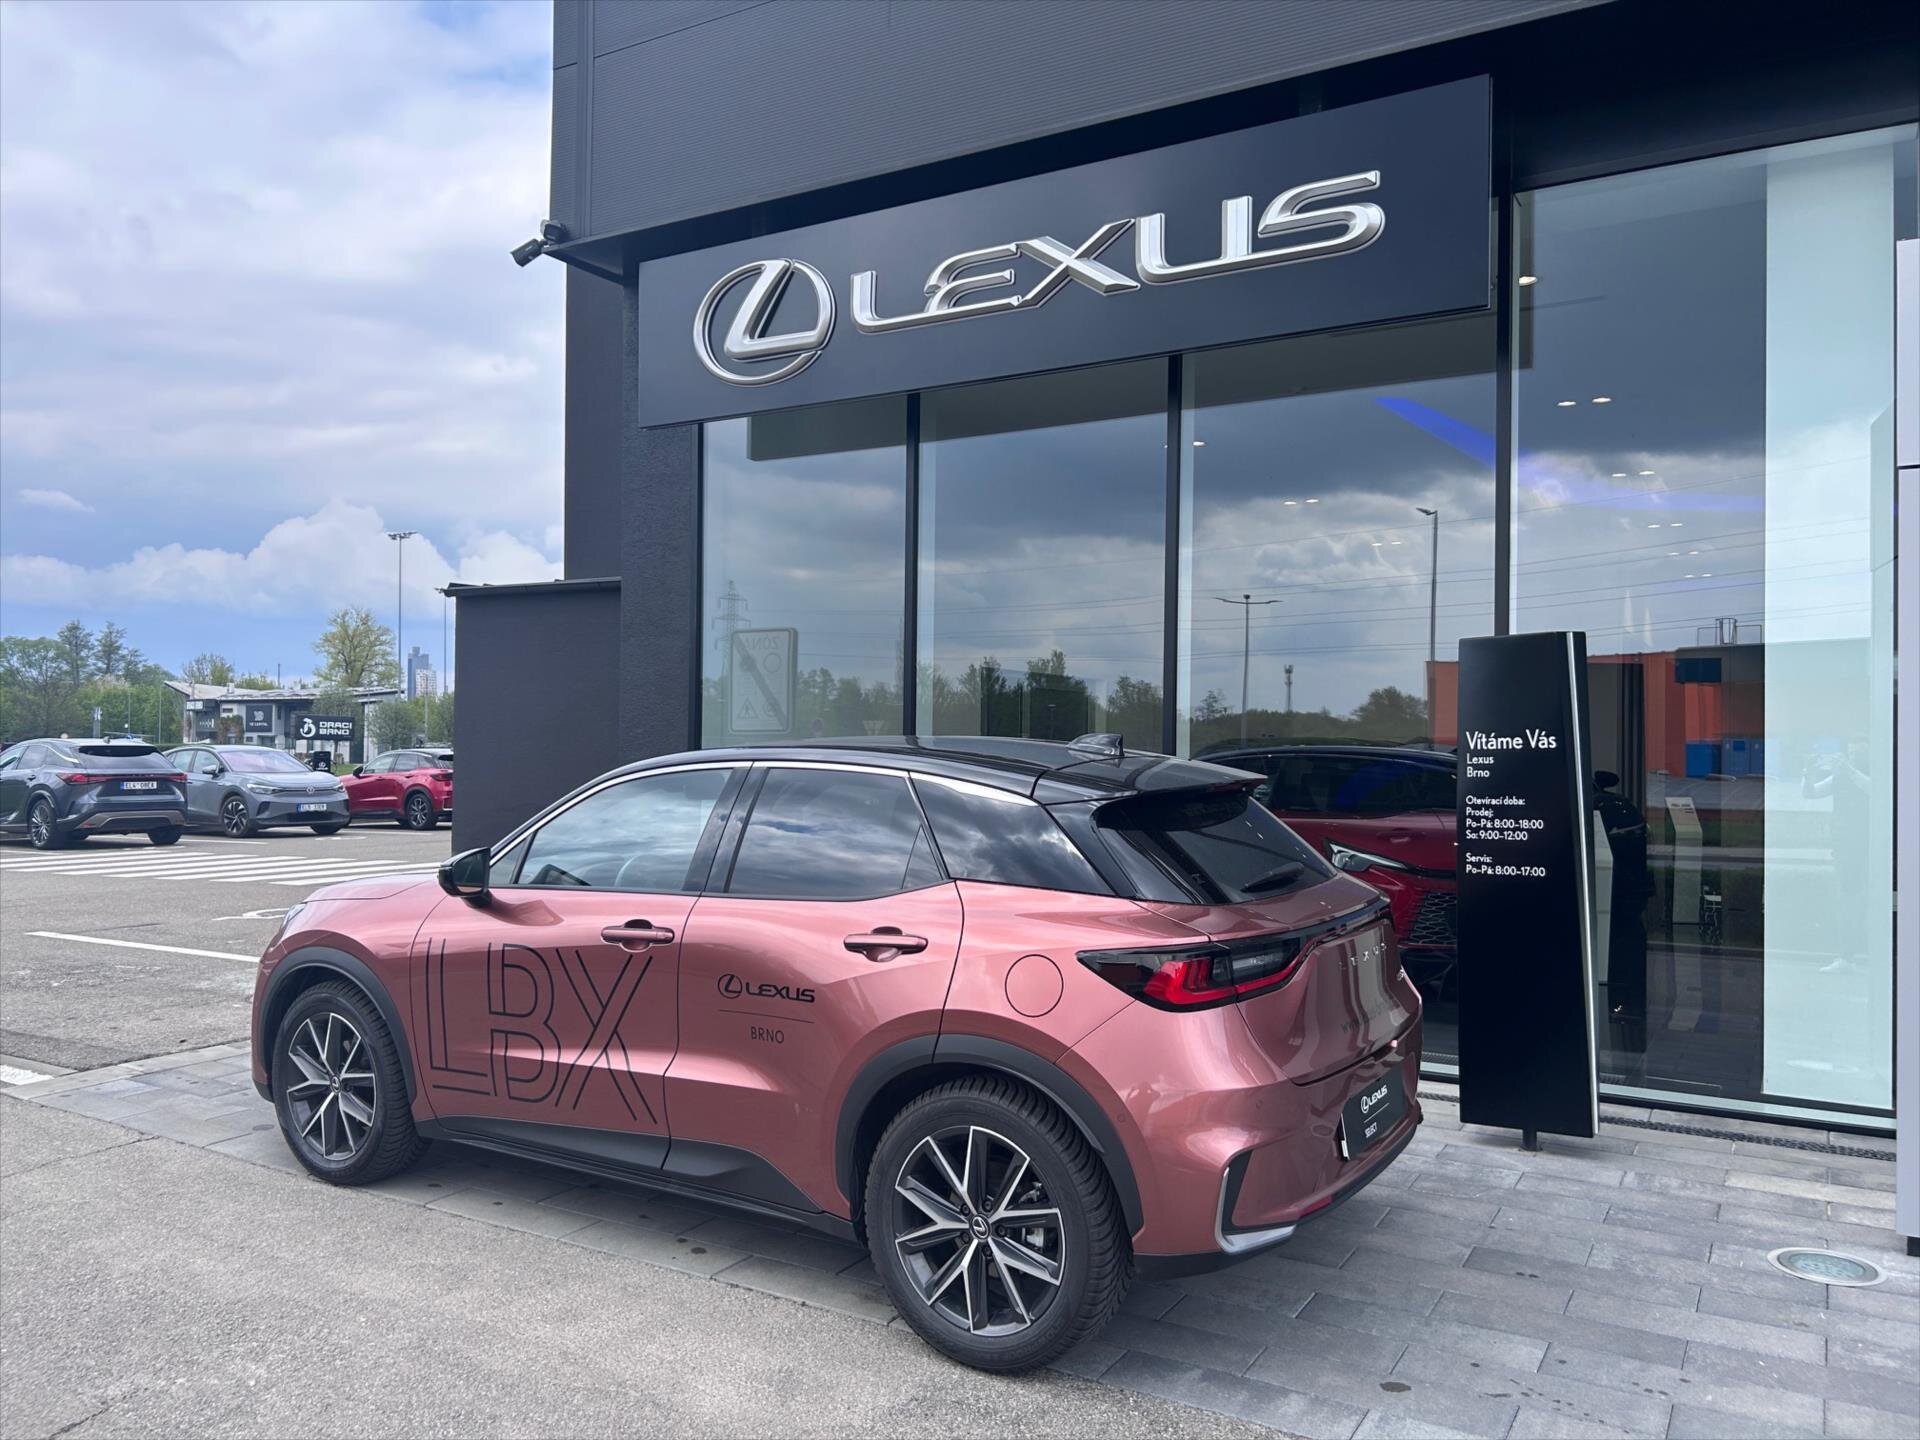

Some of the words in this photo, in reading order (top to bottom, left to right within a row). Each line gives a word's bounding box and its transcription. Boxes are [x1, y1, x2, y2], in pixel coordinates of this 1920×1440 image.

[850, 169, 1387, 335] LEXUS
[1465, 731, 1523, 750] Vítáme
[1525, 728, 1557, 749] Vás
[1466, 753, 1494, 764] Lexus
[1466, 766, 1490, 778] Brno
[1465, 795, 1502, 805] Otevírací
[1503, 795, 1526, 806] doba:
[1466, 806, 1494, 818] Prodej:
[1466, 829, 1479, 840] So:
[1465, 852, 1493, 863] Servis:
[745, 981, 816, 1004] LEXUS
[426, 937, 658, 1125] LBX
[750, 1026, 785, 1044] BRNO
[1368, 1084, 1388, 1106] LEXUS
